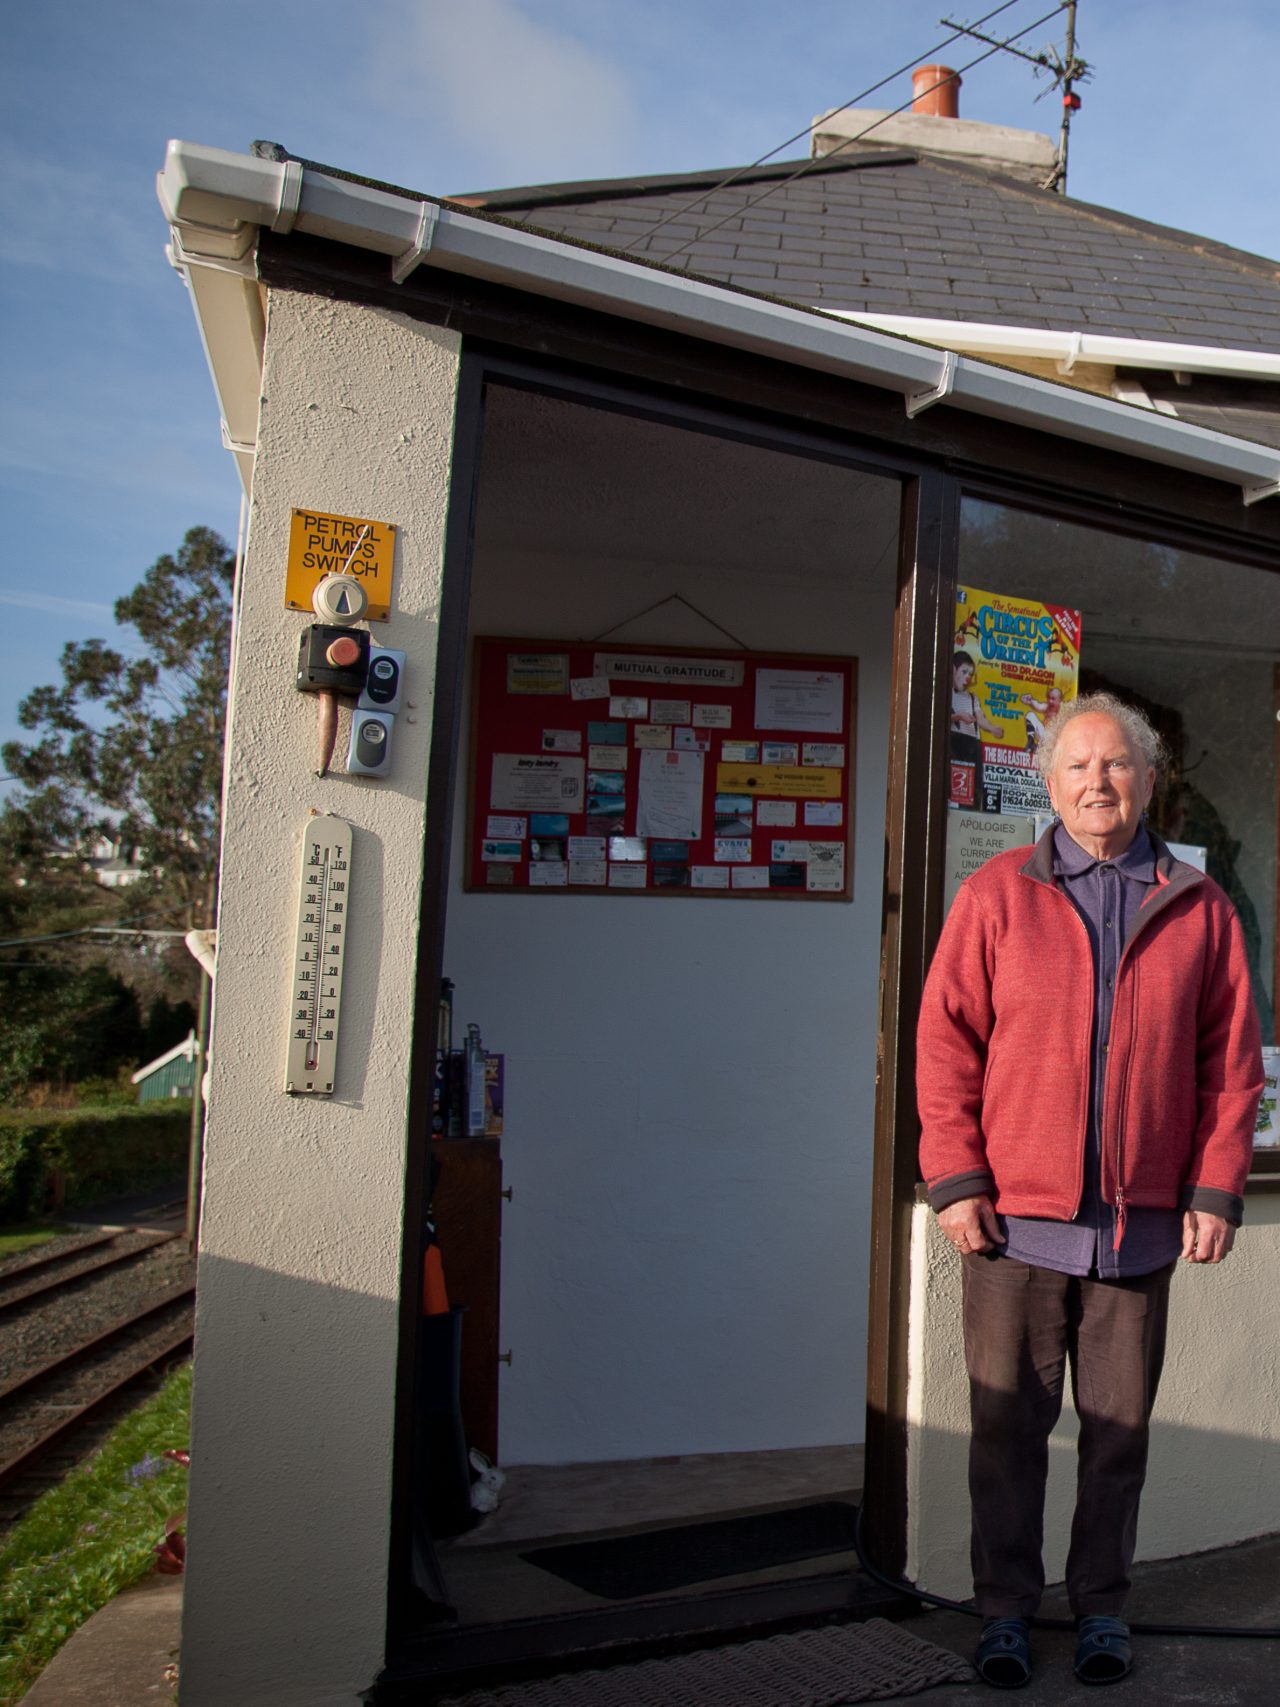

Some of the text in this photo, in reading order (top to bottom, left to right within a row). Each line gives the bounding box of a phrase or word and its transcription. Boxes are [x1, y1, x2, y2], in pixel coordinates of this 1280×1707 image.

[304, 515, 381, 542] PETROL
[308, 534, 375, 558] PUMPS
[302, 552, 379, 578] SWITCH
[1005, 603, 1042, 617] Sensational
[978, 605, 1053, 639] CIRCUS
[997, 634, 1032, 648] OF THE
[980, 636, 1050, 669] ORIENT
[614, 663, 726, 678] MUTUAL GRATITUDE
[1001, 663, 1055, 680] RED DRAGON
[991, 689, 1018, 703] EAST
[985, 746, 997, 761] THE
[997, 747, 1008, 763] BIG
[1008, 749, 1031, 768] EASTER
[985, 765, 1033, 778] ROYAL
[985, 773, 1000, 783] VILLA
[1020, 777, 1043, 787] DOUGLAS
[1003, 789, 1028, 797] BOOK
[1002, 796, 1052, 809] 01624 600555
[960, 819, 1016, 834] APOLOGIES
[970, 837, 1005, 848] WE ARE
[311, 856, 319, 865] 50
[335, 861, 347, 869] 120
[309, 875, 317, 883] 40
[333, 881, 345, 890] 100
[307, 894, 316, 902] 30
[334, 902, 343, 911] 80
[305, 913, 314, 922] 20
[305, 933, 313, 941] 10
[330, 945, 339, 953] 40
[304, 952, 309, 960] 0
[329, 967, 338, 975] 20
[330, 988, 334, 996] 0
